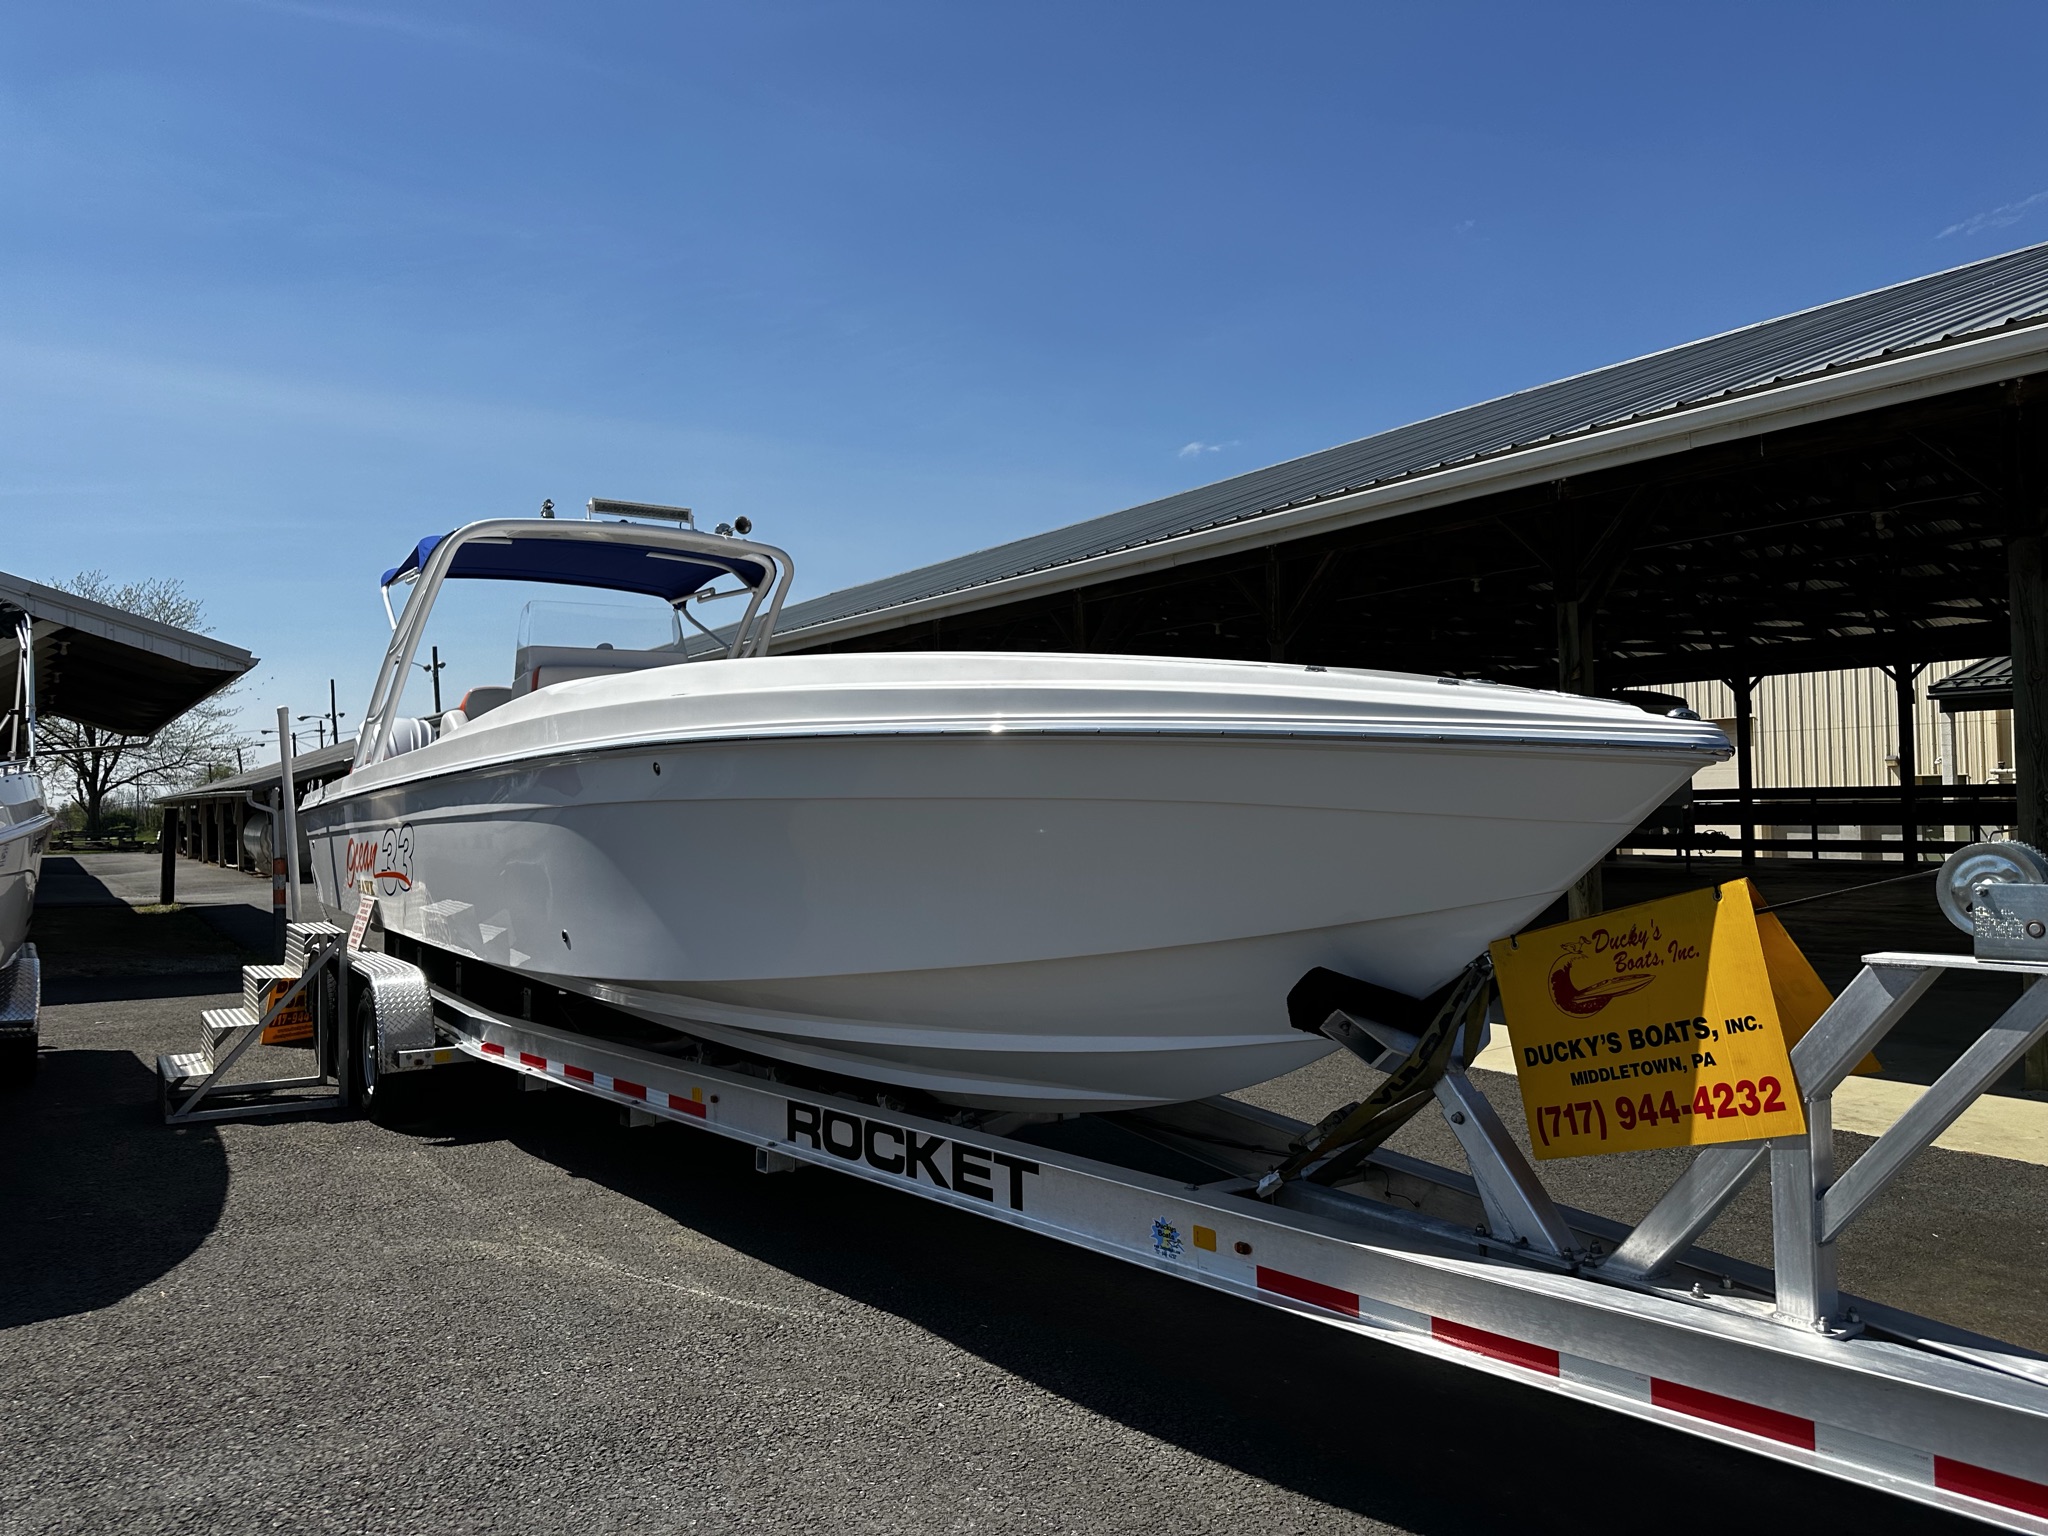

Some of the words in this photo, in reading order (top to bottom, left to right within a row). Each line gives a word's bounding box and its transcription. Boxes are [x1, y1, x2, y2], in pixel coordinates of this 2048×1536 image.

[381, 822, 415, 896] 33
[1591, 918, 1663, 954] Ducky's
[1668, 939, 1700, 962] Inc.
[1523, 1031, 1623, 1068] DUCKY'S
[1629, 1016, 1719, 1053] BOATS,
[1725, 1015, 1763, 1035] INC.
[1570, 1059, 1688, 1087] MIDDLETOWN,
[1693, 1052, 1717, 1069] PA
[1536, 1100, 1608, 1146] (717)
[1615, 1075, 1787, 1131] 944-4232
[786, 1099, 1040, 1212] ROCKET
